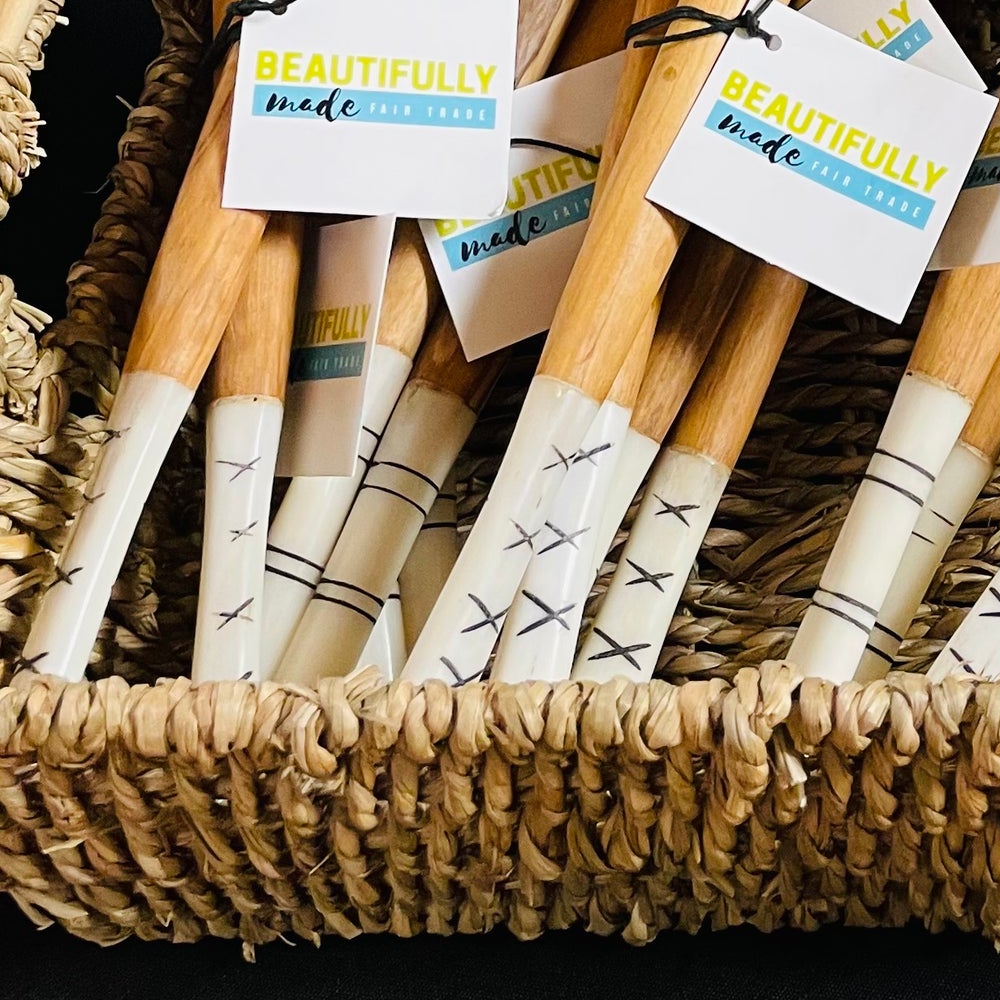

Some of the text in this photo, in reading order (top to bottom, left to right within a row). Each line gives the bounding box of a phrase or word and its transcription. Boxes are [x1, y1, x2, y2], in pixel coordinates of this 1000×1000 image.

[255, 50, 497, 95] BEAUTIFULLY
[265, 88, 487, 122] made FAIR TRADE
[719, 69, 949, 194] BEAUTIFULLY
[717, 113, 922, 219] made FAIR TRADE
[461, 210, 547, 262] made
